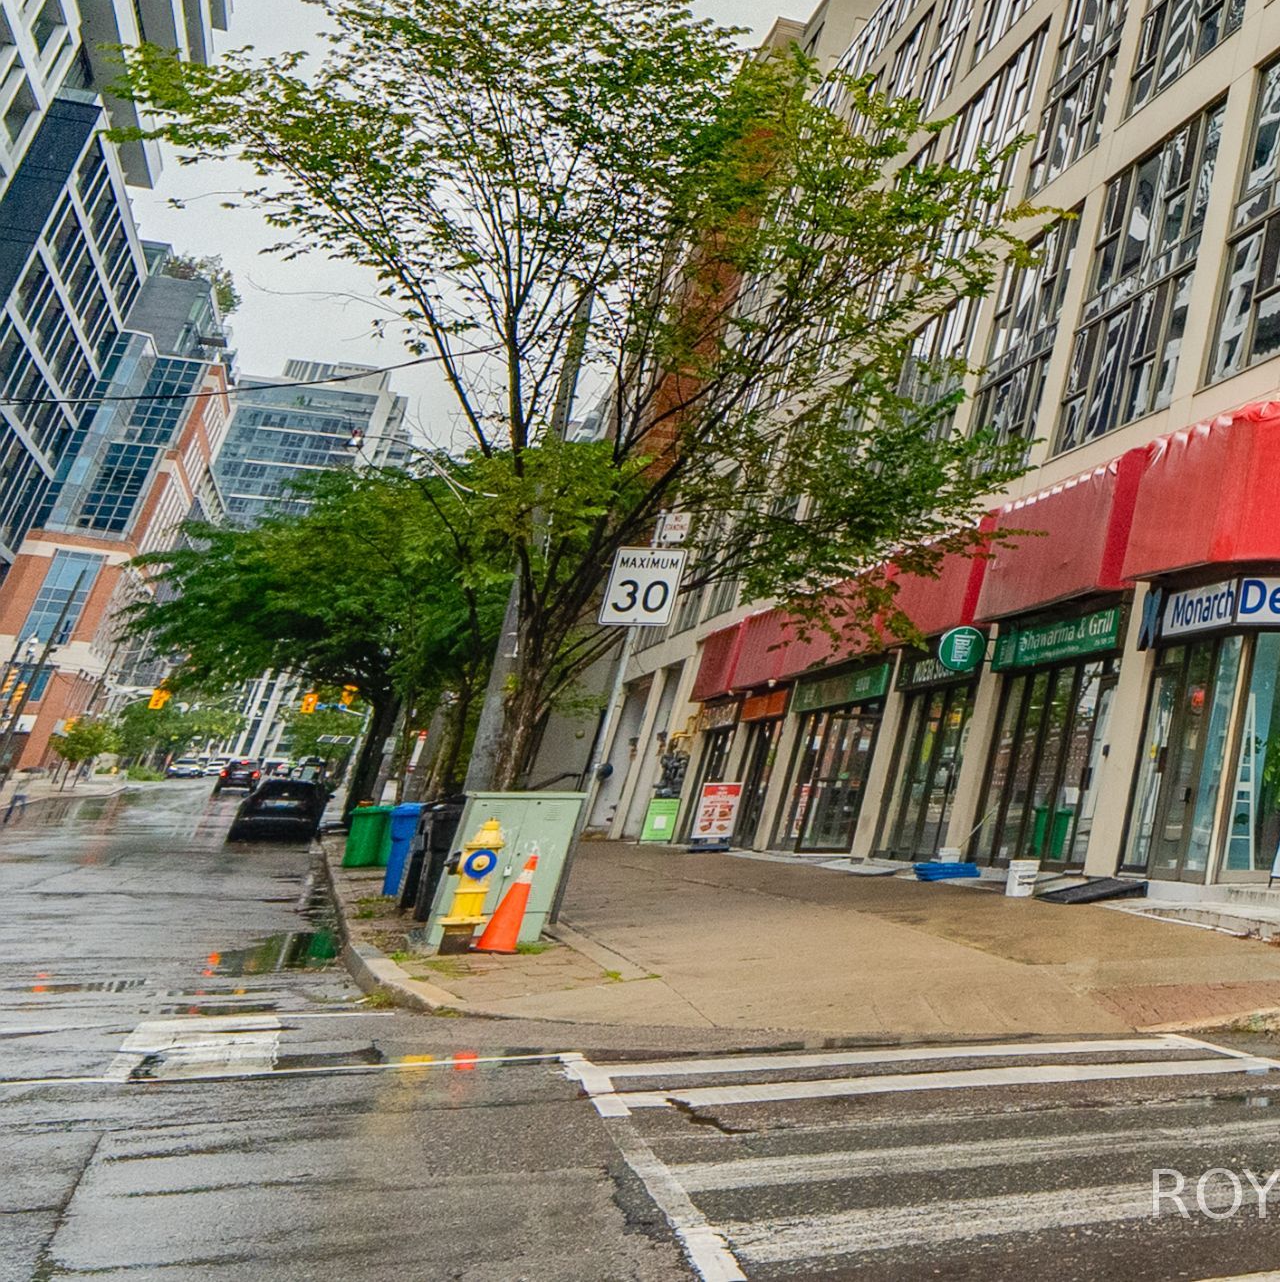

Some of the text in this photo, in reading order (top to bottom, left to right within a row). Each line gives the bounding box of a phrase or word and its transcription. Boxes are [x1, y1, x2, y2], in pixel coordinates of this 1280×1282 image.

[619, 557, 680, 570] MAXIMUM
[611, 579, 670, 613] 30
[1170, 581, 1234, 628] Monarch
[1020, 627, 1075, 652] Shawarma
[1077, 622, 1087, 640] &
[1088, 610, 1115, 636] Grill
